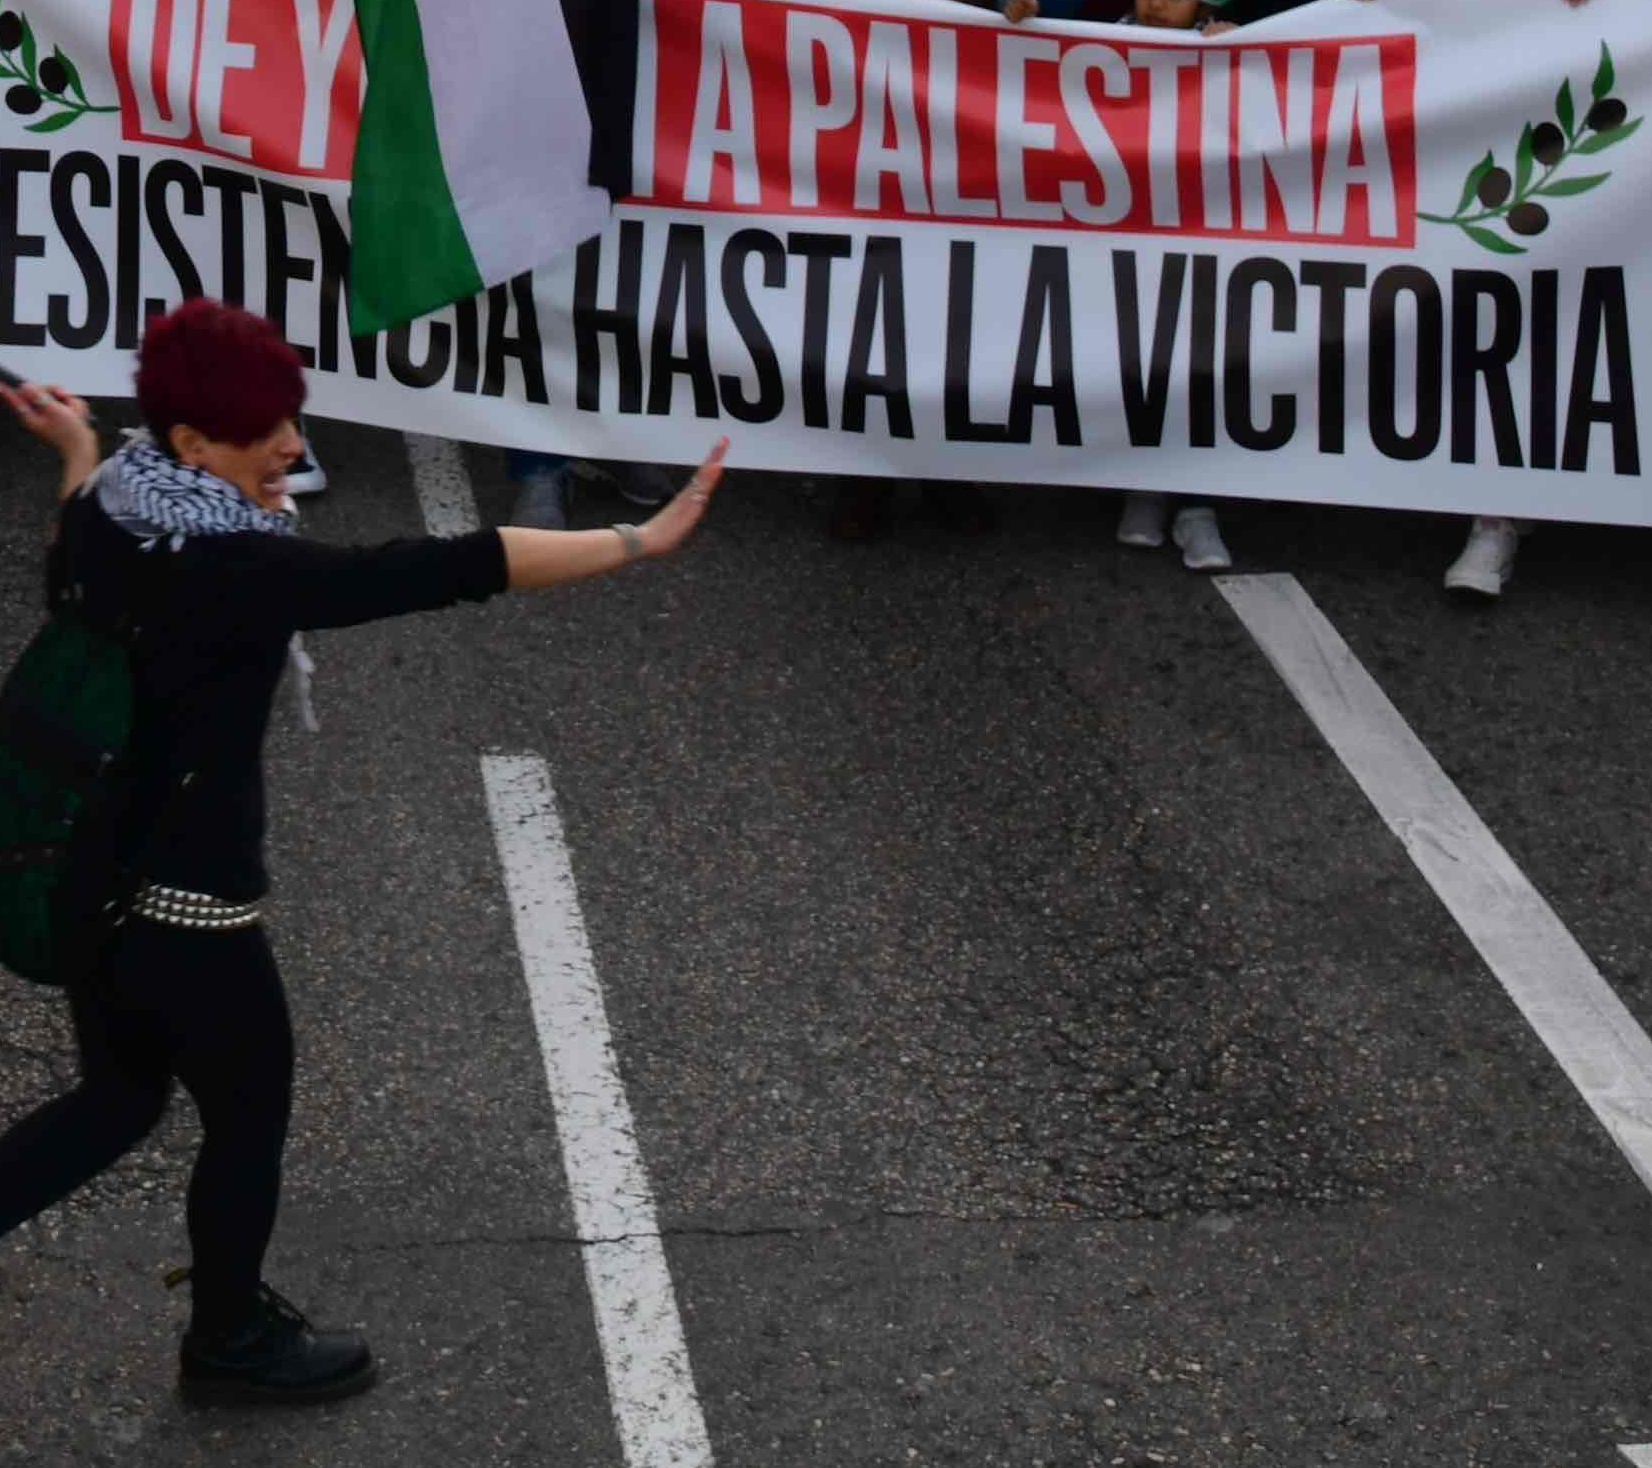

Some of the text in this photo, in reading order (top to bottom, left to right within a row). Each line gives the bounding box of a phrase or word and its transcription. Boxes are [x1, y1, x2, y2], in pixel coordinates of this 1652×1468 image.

[784, 2, 1401, 239] PALESTINA
[574, 213, 914, 441] HASTA
[943, 241, 1078, 445] LA
[1110, 246, 1643, 476] VICTORIA
